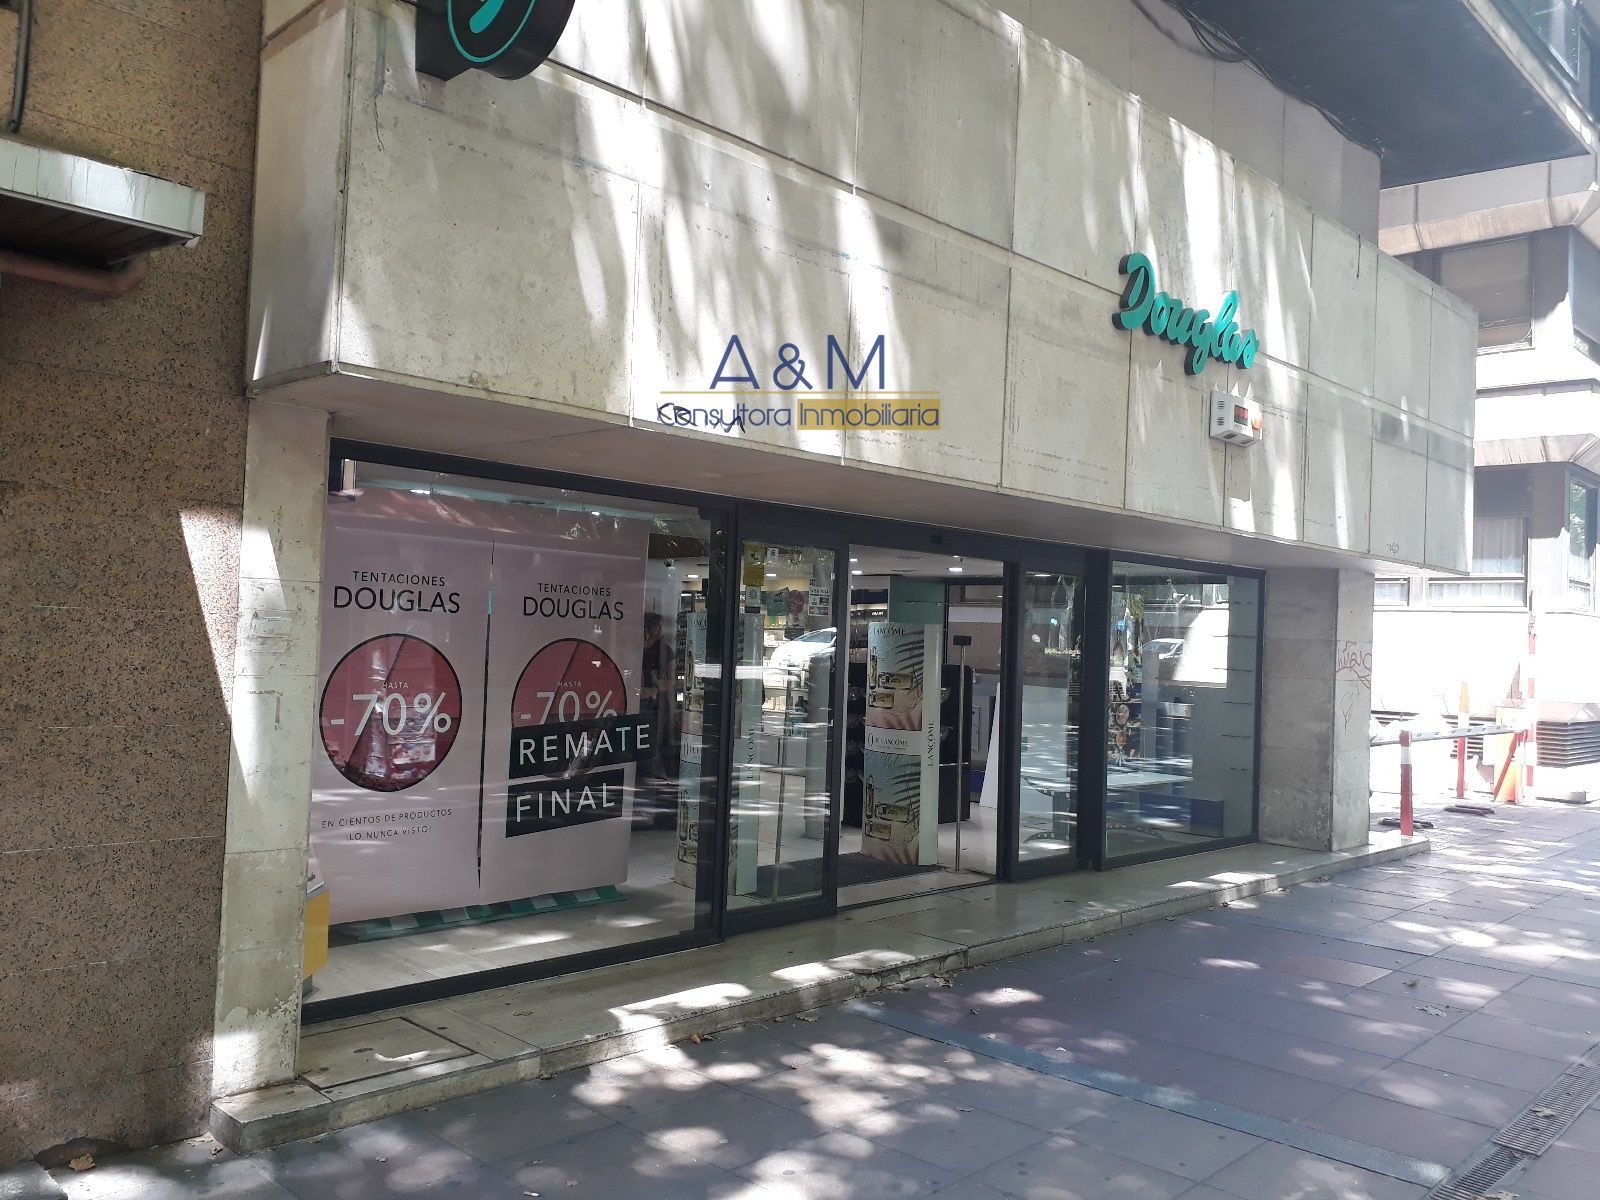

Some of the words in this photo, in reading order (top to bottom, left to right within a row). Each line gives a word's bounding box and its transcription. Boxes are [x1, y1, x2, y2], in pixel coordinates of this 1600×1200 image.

[1111, 252, 1260, 376] Douglas
[352, 570, 446, 588] TENTACIONES
[537, 582, 612, 598] TENTACIONES
[333, 585, 461, 614] DOUGLAS
[522, 596, 625, 621] DOUGLAS
[382, 681, 409, 689] HASTA
[557, 680, 582, 688] HASTA
[330, 691, 452, 736] -70%
[520, 690, 618, 725] -70%
[519, 723, 650, 766] REMATE
[515, 782, 615, 823] FINAL
[321, 820, 334, 829] EN
[338, 815, 381, 827] CIENTOS
[384, 813, 396, 822] DE
[399, 808, 452, 820] PRODUCTOS
[366, 828, 399, 839] NUNCA
[402, 825, 432, 836] VISTO!
